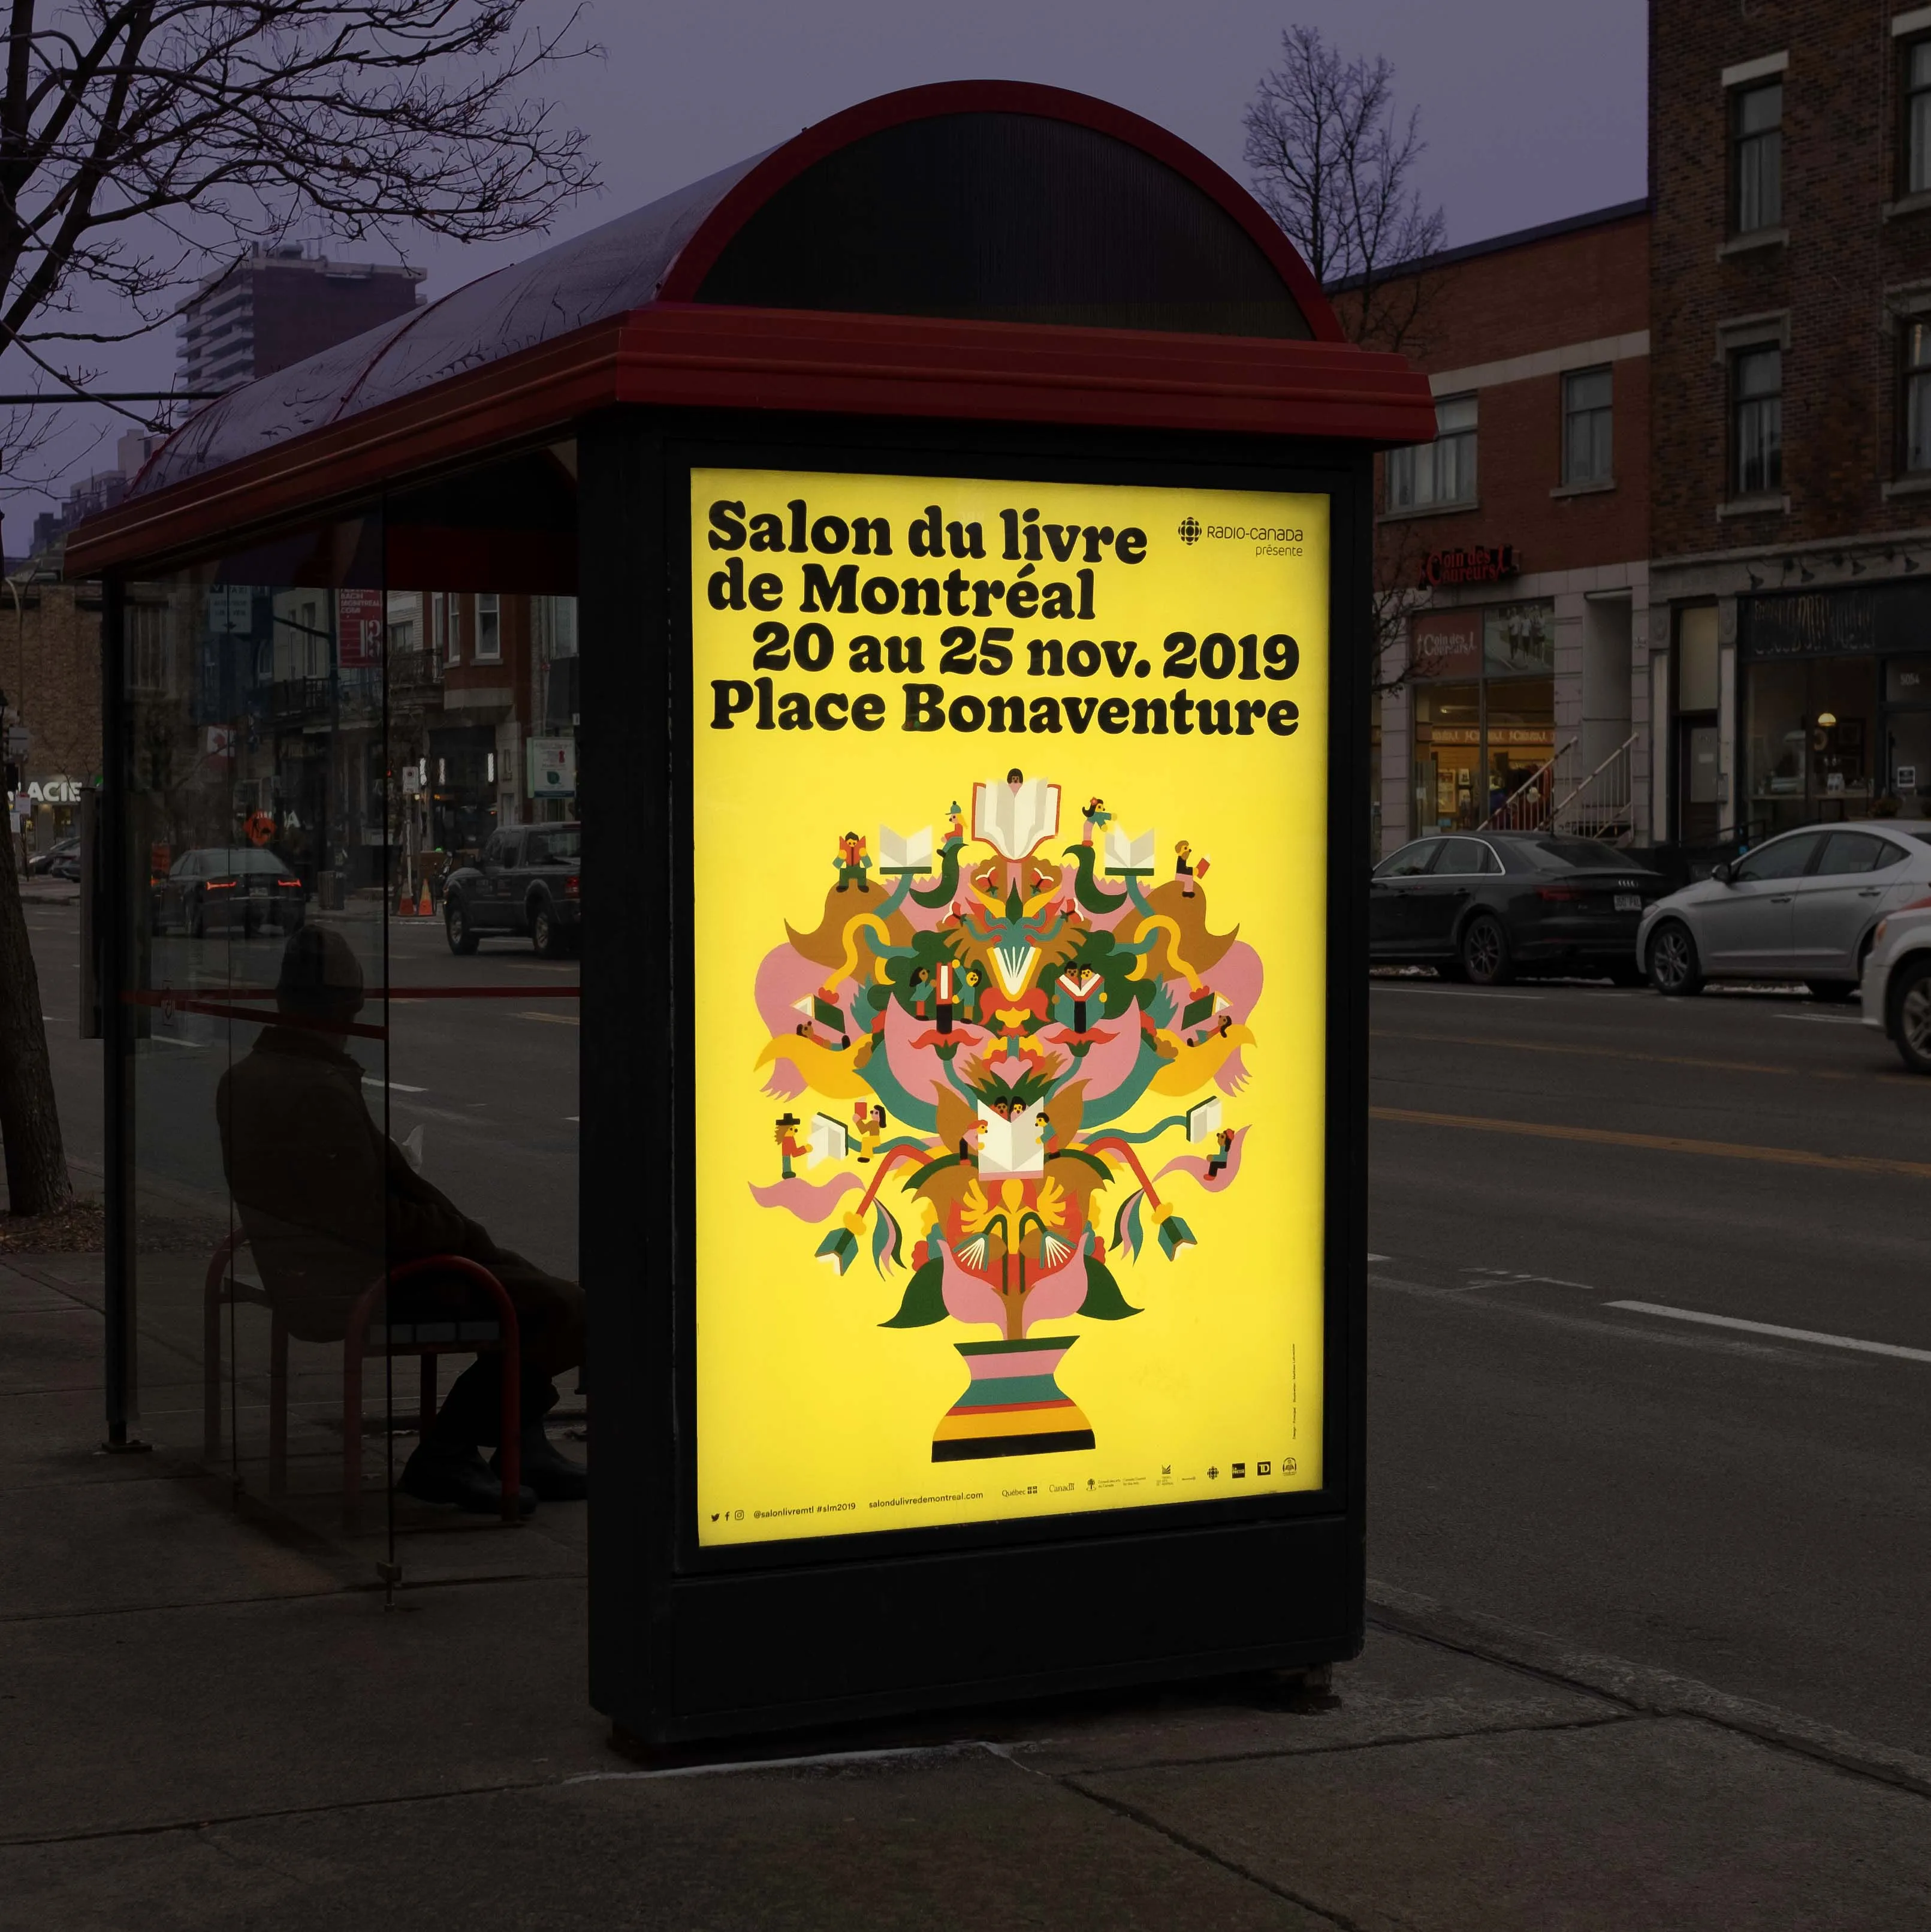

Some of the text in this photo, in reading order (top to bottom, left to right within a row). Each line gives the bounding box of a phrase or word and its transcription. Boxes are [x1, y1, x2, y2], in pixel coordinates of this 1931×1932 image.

[708, 499, 1148, 564] Salon du livre
[1256, 545, 1303, 557] présente
[708, 557, 1096, 620] de Montréal
[752, 622, 1299, 681] 20 au 25 nov. 2019
[710, 677, 1299, 737] Place Bonaventure
[1001, 1488, 1026, 1497] Québec
[1049, 1483, 1075, 1493] Canada
[869, 1491, 983, 1508] salondulivredemontreal.com
[753, 1502, 856, 1519] @salonlivremtl #slm2019
